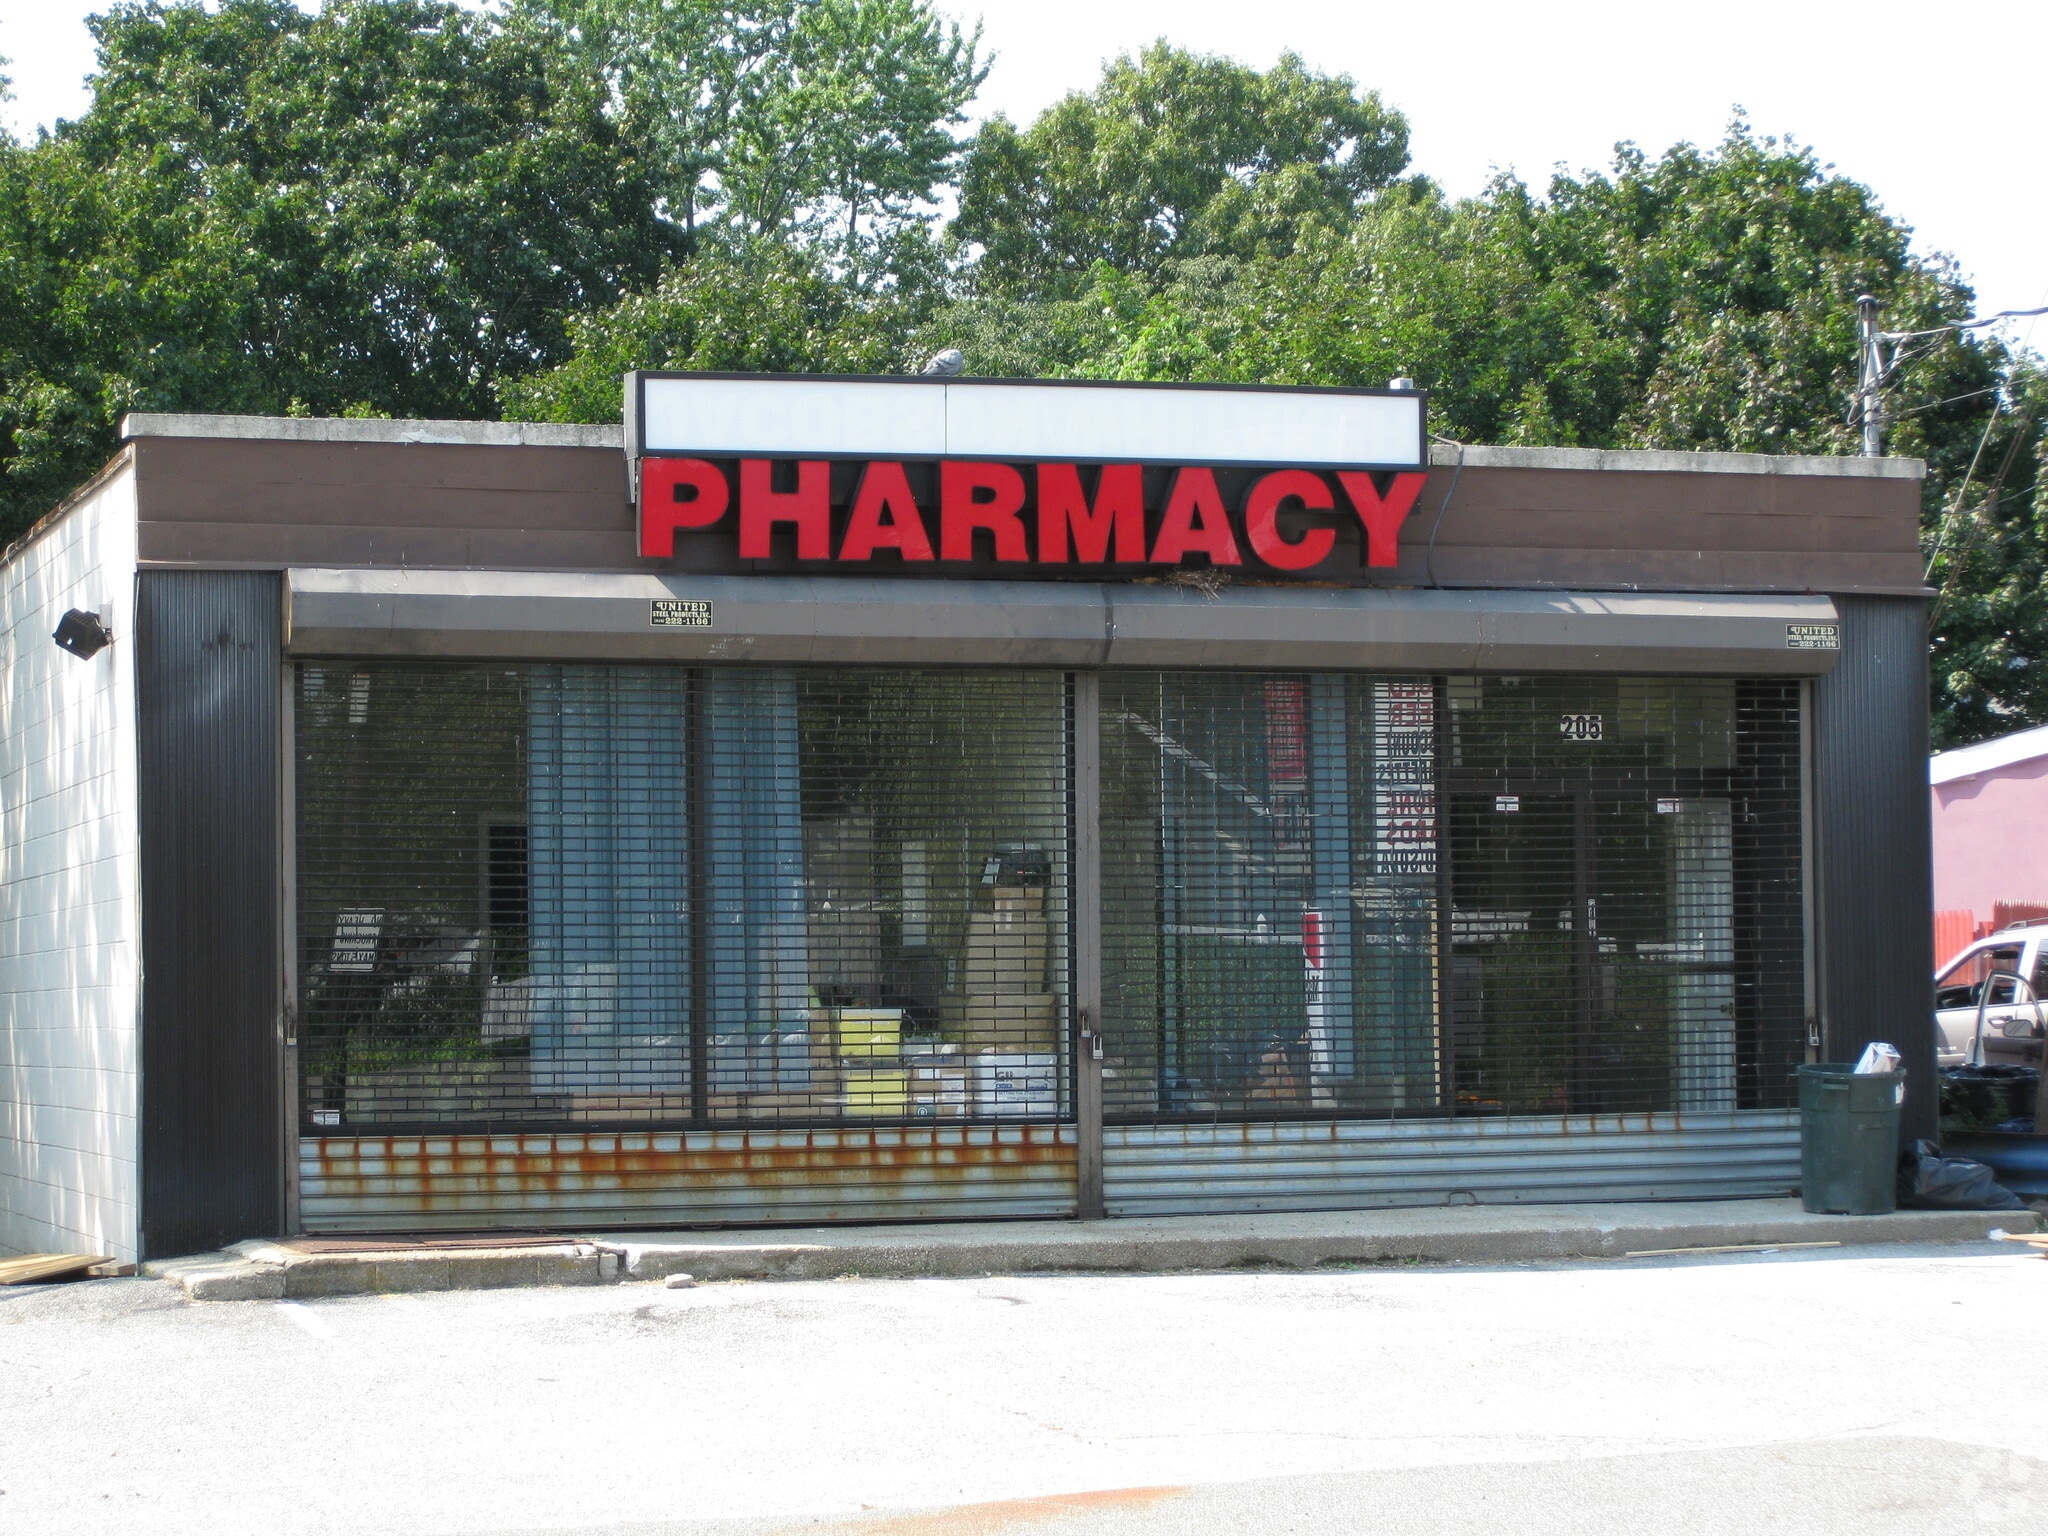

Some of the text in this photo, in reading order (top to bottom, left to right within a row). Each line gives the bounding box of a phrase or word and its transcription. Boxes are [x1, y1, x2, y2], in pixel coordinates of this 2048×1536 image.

[637, 457, 1428, 569] PHARMACY
[656, 602, 707, 611] UNITED
[1791, 626, 1834, 635] UNITED
[1561, 715, 1600, 739] 205
